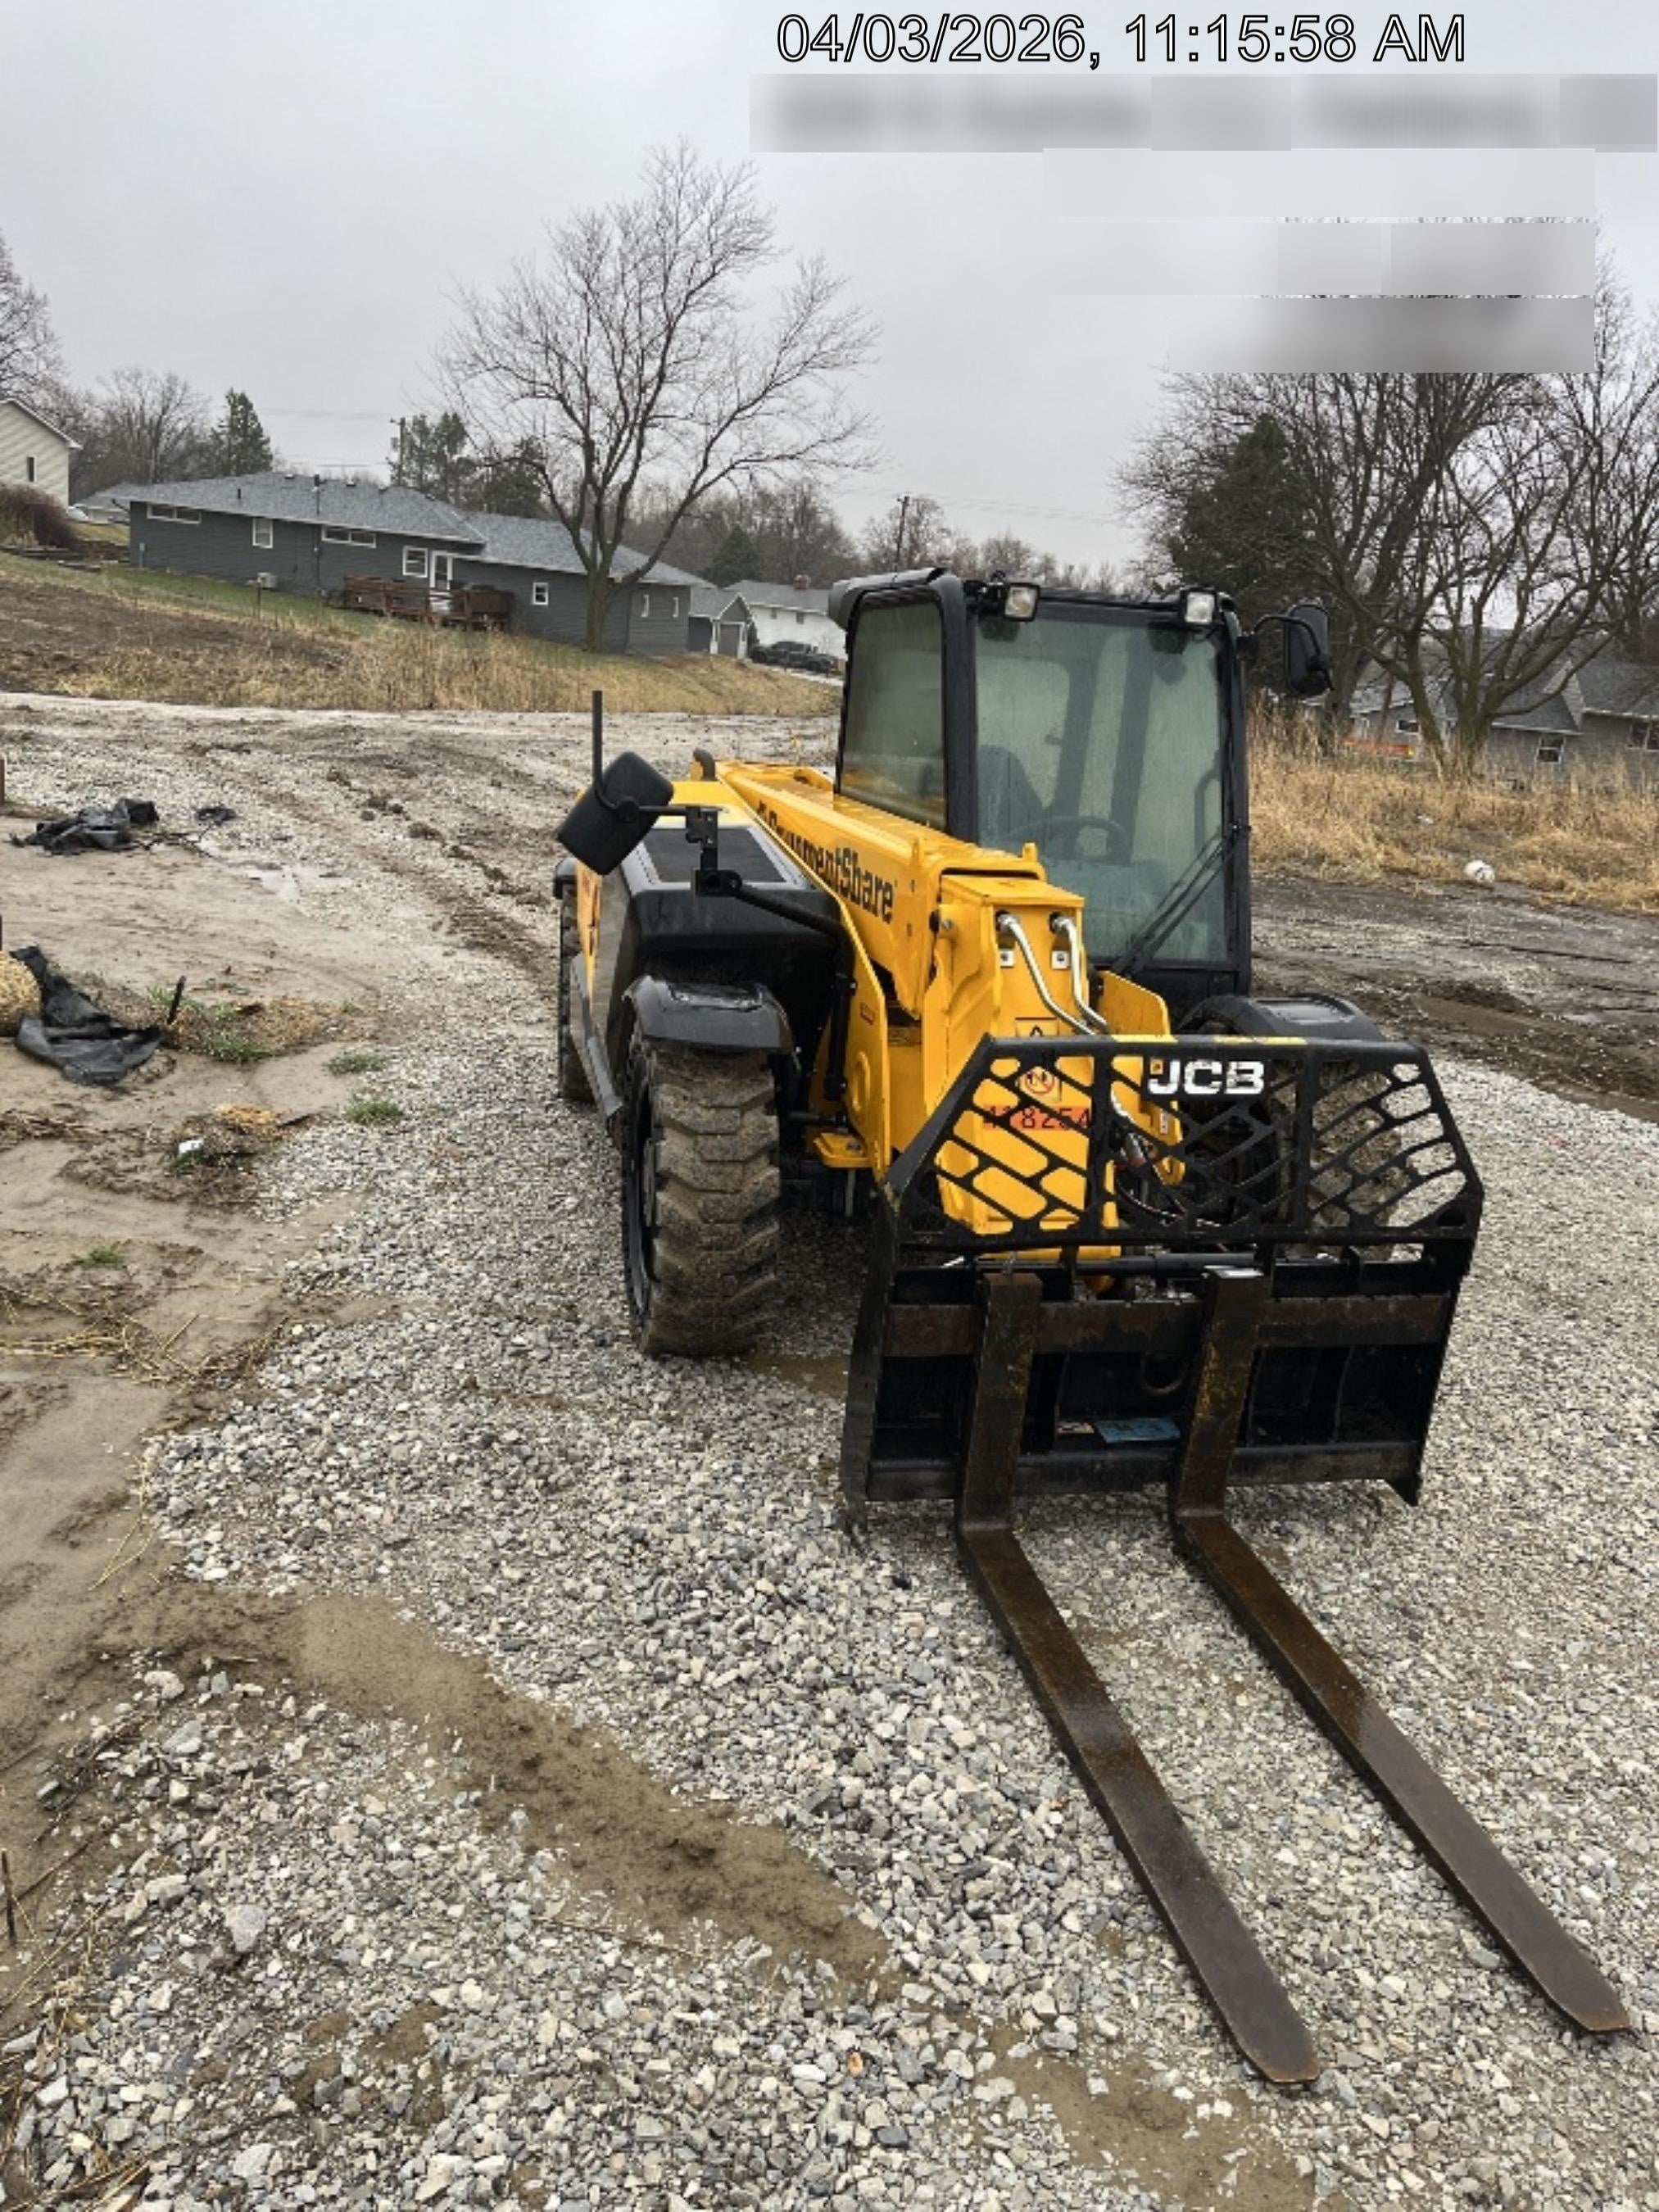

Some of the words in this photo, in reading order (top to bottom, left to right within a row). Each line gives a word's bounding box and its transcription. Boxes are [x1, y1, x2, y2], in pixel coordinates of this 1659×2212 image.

[757, 800, 894, 924] mentShare
[1149, 1058, 1264, 1095] JCB
[983, 1105, 1091, 1129] 48254
